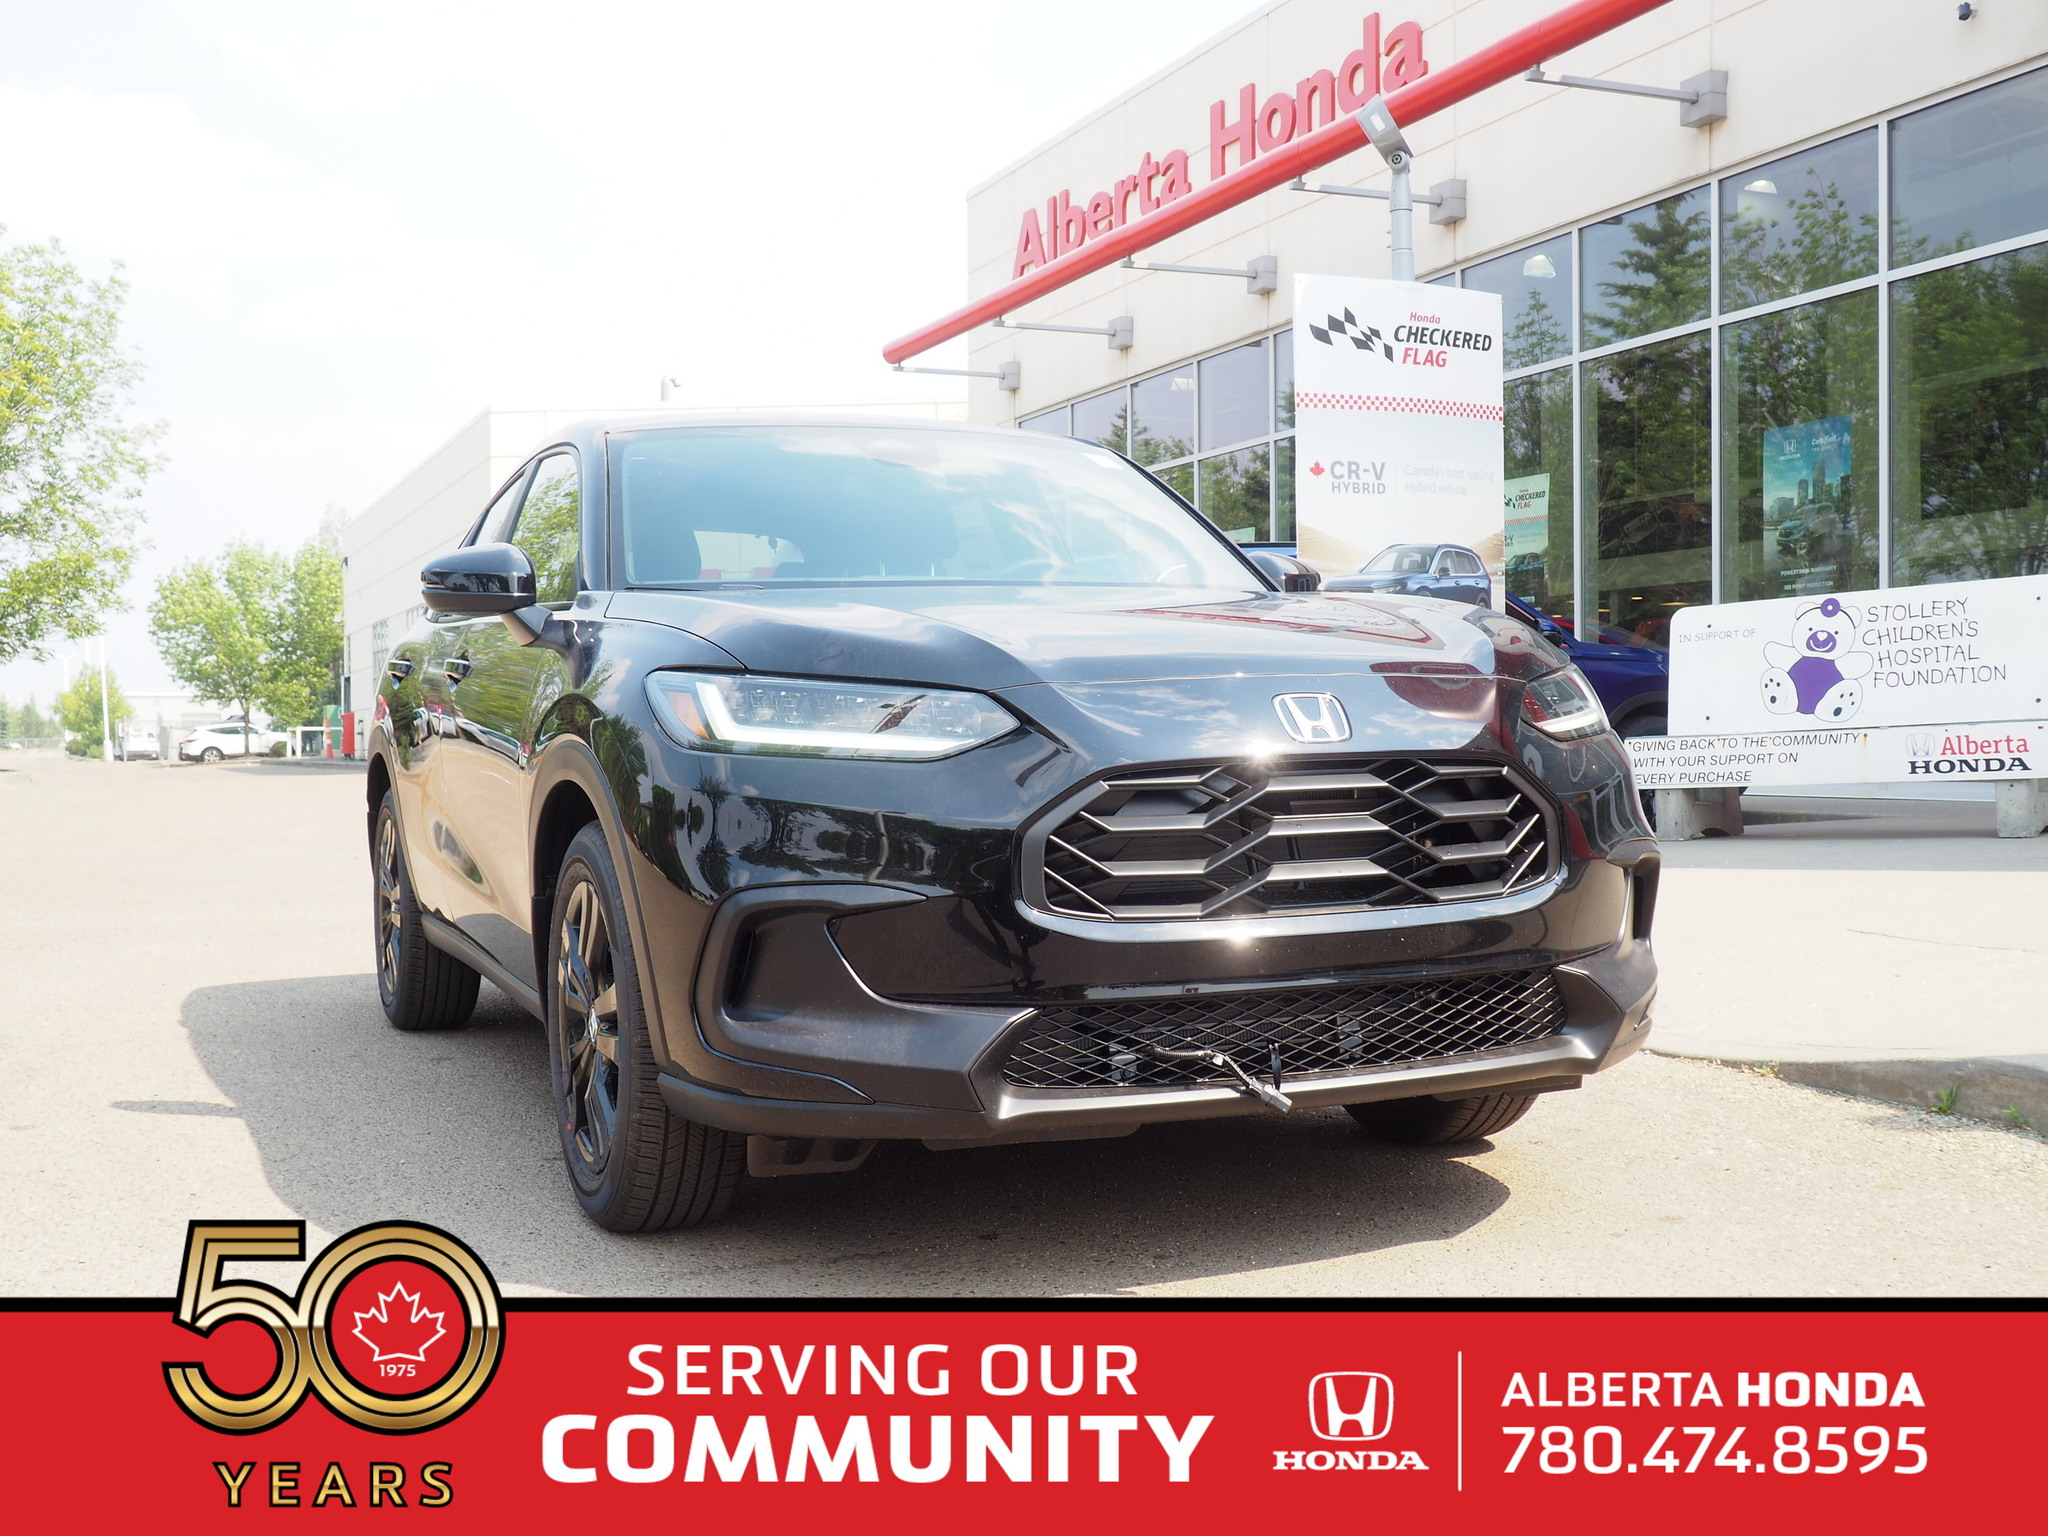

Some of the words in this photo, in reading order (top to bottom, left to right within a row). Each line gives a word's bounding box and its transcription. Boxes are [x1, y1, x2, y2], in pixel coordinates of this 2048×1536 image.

[1012, 149, 1192, 280] Alberta
[1210, 11, 1428, 182] Honda
[1409, 311, 1441, 324] Honda
[1393, 325, 1493, 352] CHECKERED
[1402, 347, 1448, 368] FLAG
[1330, 460, 1386, 481] CR-V
[1331, 482, 1387, 495] HYBRID
[1515, 490, 1546, 501] CHECKERED
[1517, 501, 1531, 509] FLAG
[1867, 597, 1968, 623] STOLLERY
[1678, 634, 1691, 643] IN
[1694, 630, 1740, 642] SUPPORT
[1742, 628, 1757, 638] OF
[1862, 618, 1978, 646] CHILDREN'S
[1877, 644, 1980, 668] HOSPITAL
[1873, 665, 2006, 688] FOUNDATION
[1632, 740, 1676, 752] GIVING
[1680, 738, 1716, 751] BACK
[1720, 737, 1738, 749] TO
[1742, 736, 1769, 748] THE
[1771, 732, 1861, 748] COMMUNITY
[1940, 735, 2029, 756] Alberta
[1634, 757, 1665, 768] WITH
[1669, 755, 1706, 767] YOUR
[1709, 752, 1774, 766] SUPPORT
[1777, 752, 1799, 764] ON
[1908, 757, 2032, 775] HONDA
[1635, 772, 1675, 785] EVERY
[1679, 770, 1752, 784] PURCHASE
